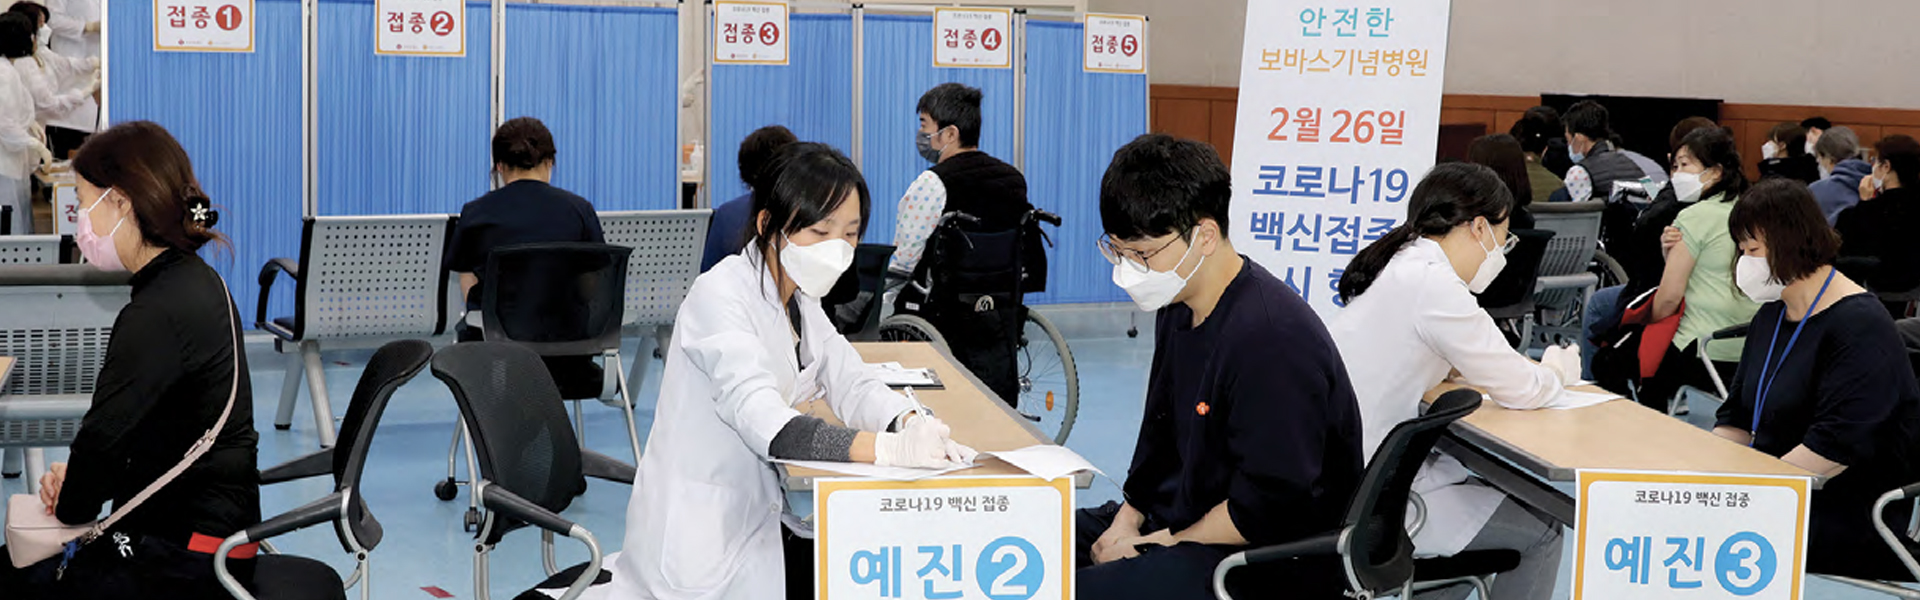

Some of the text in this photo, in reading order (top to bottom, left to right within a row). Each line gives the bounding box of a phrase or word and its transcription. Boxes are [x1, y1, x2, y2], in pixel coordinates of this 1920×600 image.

[167, 6, 210, 28] 접종
[387, 12, 425, 33] 접종
[1299, 7, 1395, 38] 안전한
[723, 23, 756, 44] 접종
[943, 29, 978, 49] 접종
[1092, 35, 1118, 55] 접종
[1258, 48, 1429, 77] 보바스기념병원
[1267, 107, 1406, 146] 2월 26일
[1252, 164, 1410, 205] 코로나19
[879, 495, 1010, 513] 코로나19 백신 접종
[1634, 490, 1751, 509] 코로나19 백신 접종
[849, 544, 964, 600] 예진
[1604, 536, 1706, 589] 예진
